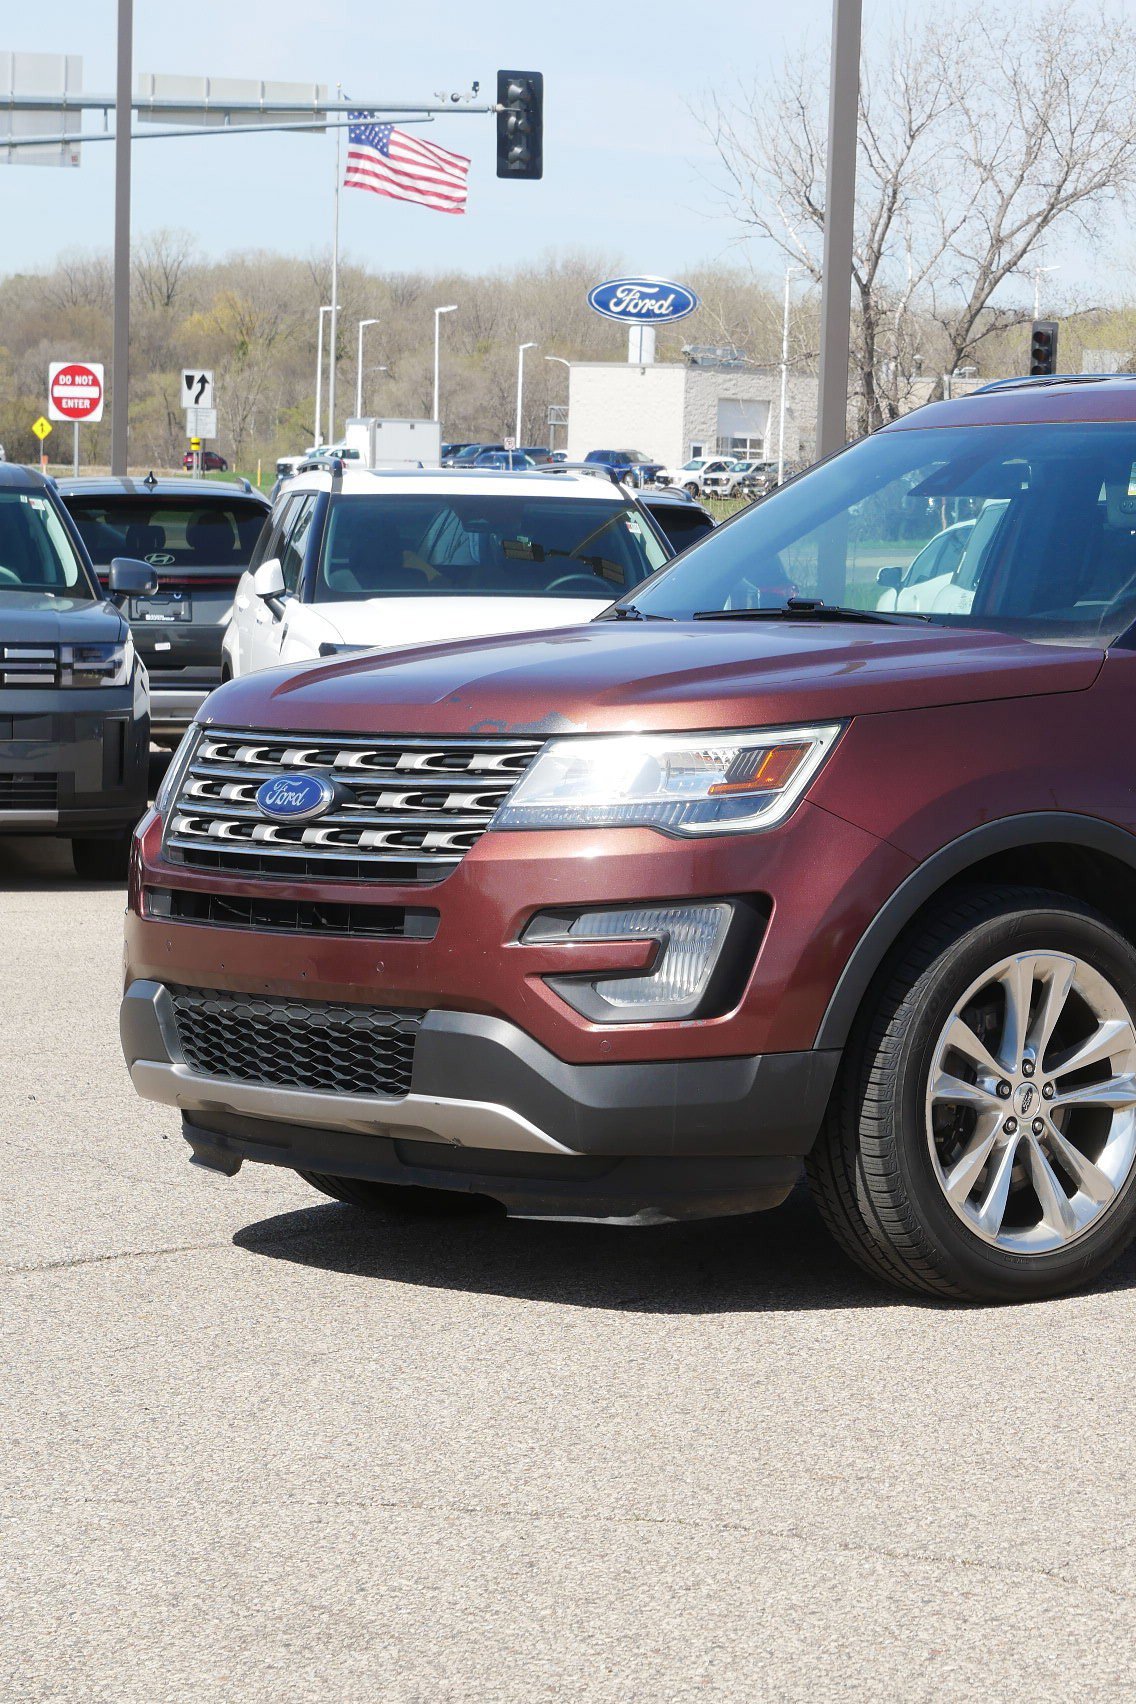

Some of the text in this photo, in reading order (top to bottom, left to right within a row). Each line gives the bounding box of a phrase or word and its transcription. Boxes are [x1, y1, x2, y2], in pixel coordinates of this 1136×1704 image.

[609, 285, 676, 314] Ford
[59, 375, 93, 385] DO NOT
[62, 399, 91, 409] ENTER
[265, 779, 310, 806] Ford
